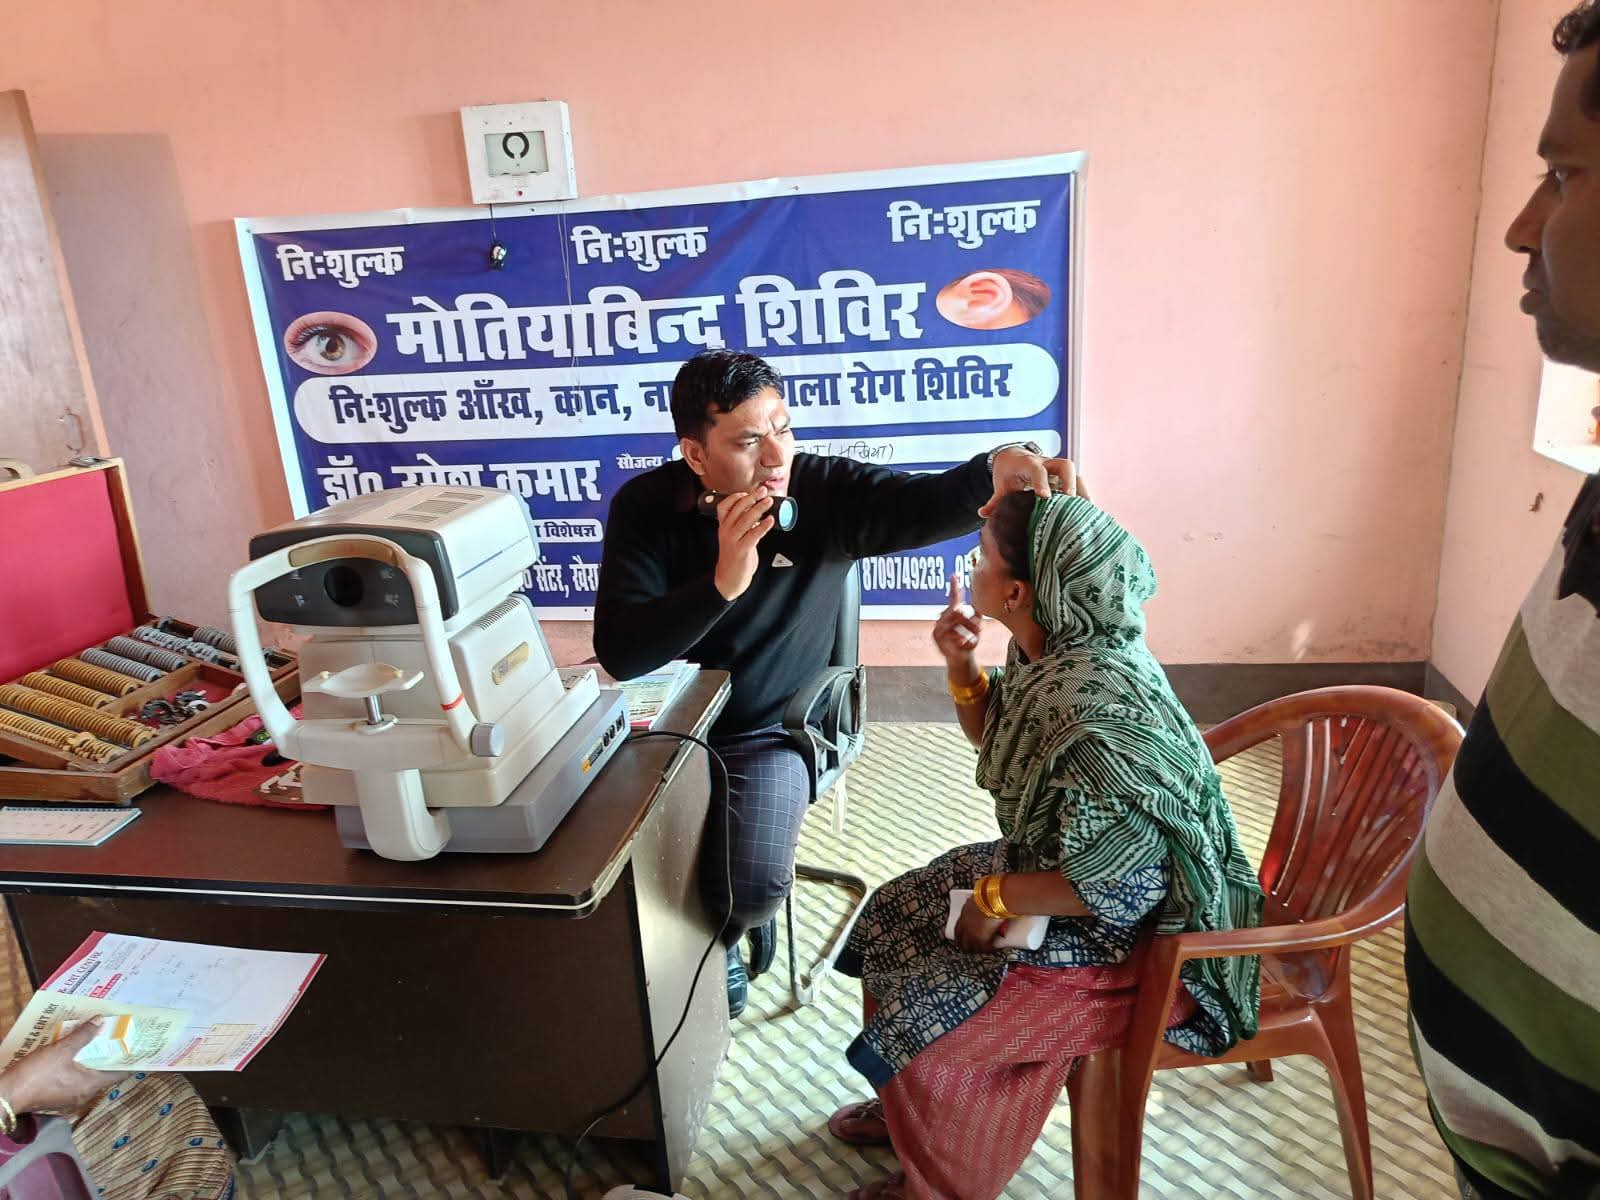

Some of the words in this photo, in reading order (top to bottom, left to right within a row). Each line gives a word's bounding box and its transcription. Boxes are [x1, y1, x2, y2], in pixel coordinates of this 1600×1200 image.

[386, 286, 726, 363] मोतियाबिन्द
[735, 269, 927, 348] शिविर
[549, 382, 633, 422] कान,
[847, 362, 906, 404] रोग
[912, 355, 1014, 402] शिविर
[543, 520, 598, 538] विशेषज्ञ
[861, 554, 952, 598] 8709749233,
